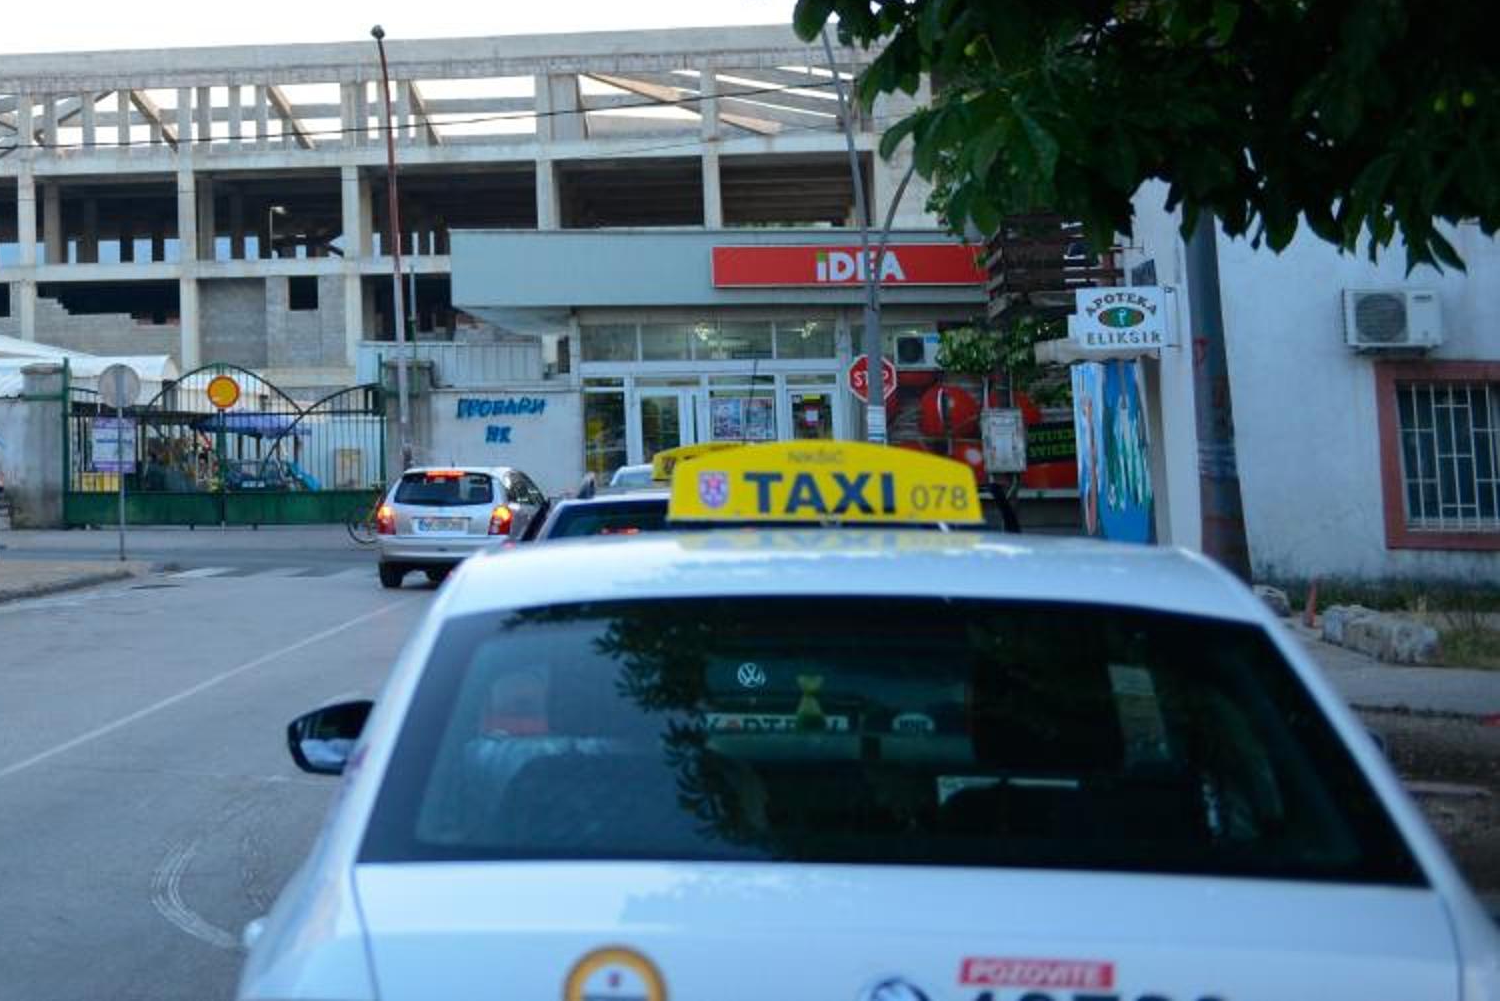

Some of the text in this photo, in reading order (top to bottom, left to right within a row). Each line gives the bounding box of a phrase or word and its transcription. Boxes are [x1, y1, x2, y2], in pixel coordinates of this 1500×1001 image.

[1086, 292, 1157, 316] APOTEKA
[1087, 330, 1160, 345] ELIKSIR
[743, 472, 896, 515] TAXI
[910, 485, 969, 512] 078
